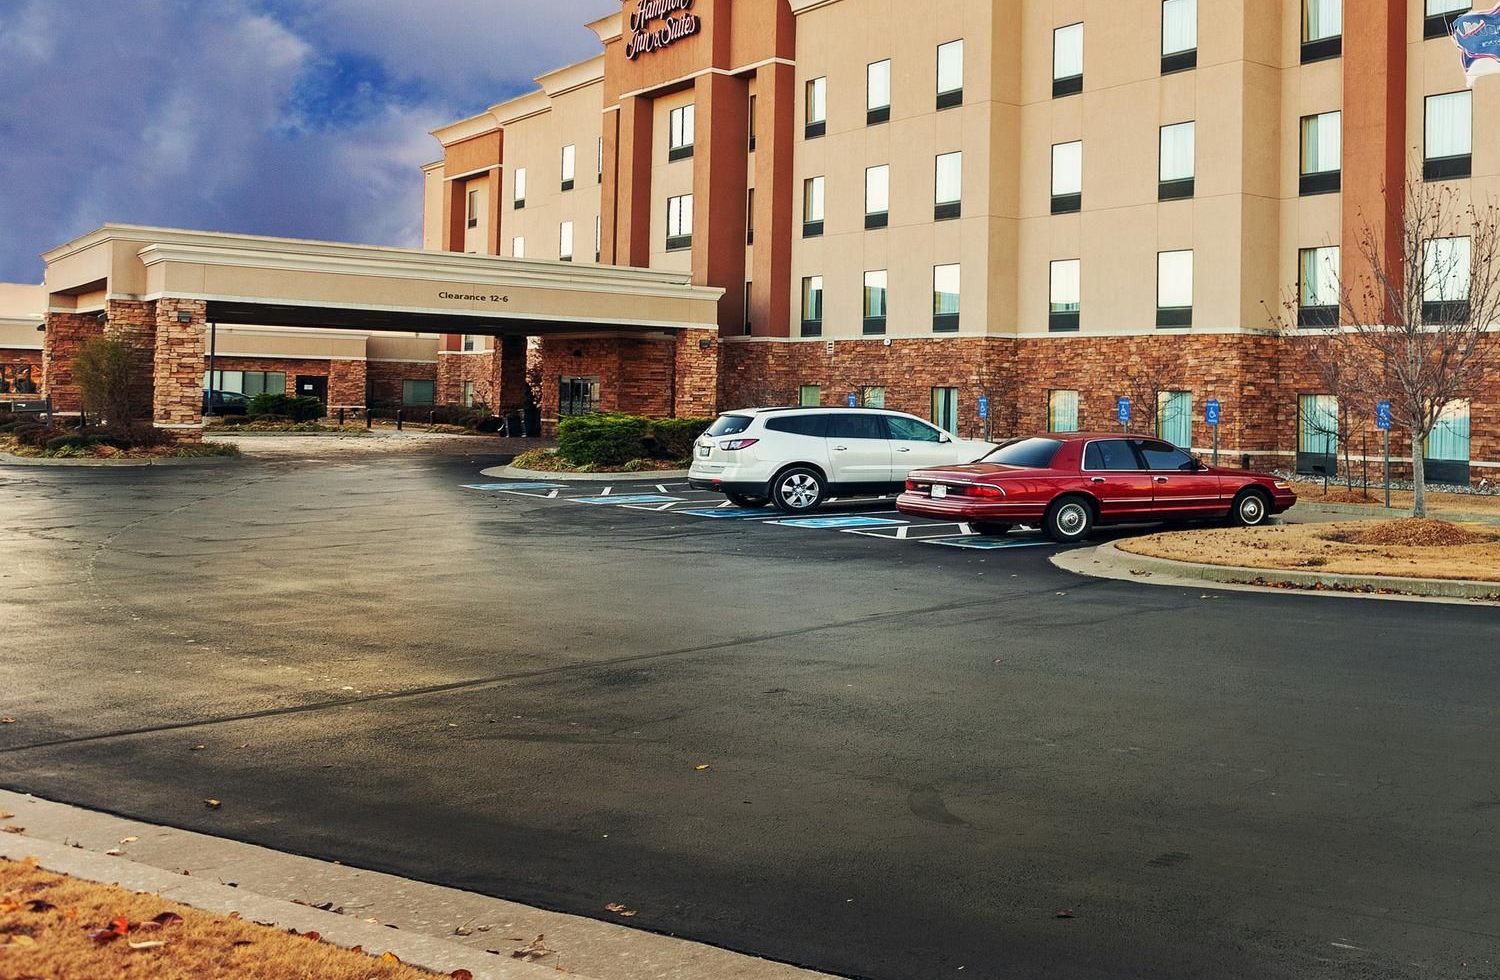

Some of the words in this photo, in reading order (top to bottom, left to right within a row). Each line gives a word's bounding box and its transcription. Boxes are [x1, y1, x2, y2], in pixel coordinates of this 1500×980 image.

[625, 30, 655, 59] Inn
[661, 13, 696, 44] Suites
[438, 291, 487, 302] Clearance
[489, 295, 509, 303] 12-6
